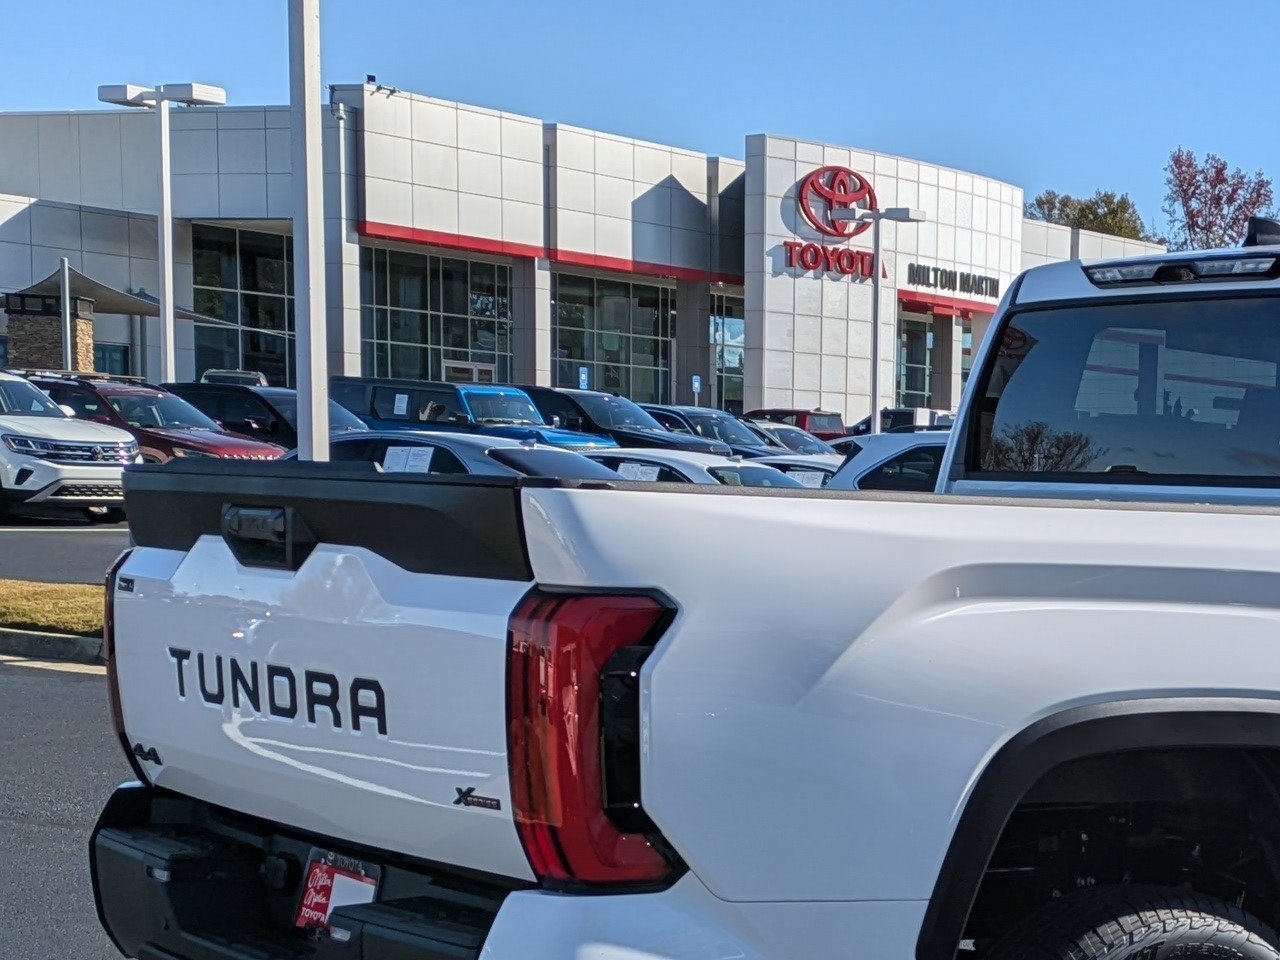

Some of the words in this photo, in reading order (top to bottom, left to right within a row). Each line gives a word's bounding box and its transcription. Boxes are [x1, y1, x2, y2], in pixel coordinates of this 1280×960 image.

[783, 241, 888, 279] TOYOTA
[908, 262, 957, 293] MILTON
[959, 271, 999, 299] MARTIN
[168, 647, 388, 736] TUNDRA
[301, 906, 326, 922] TOYOTA
